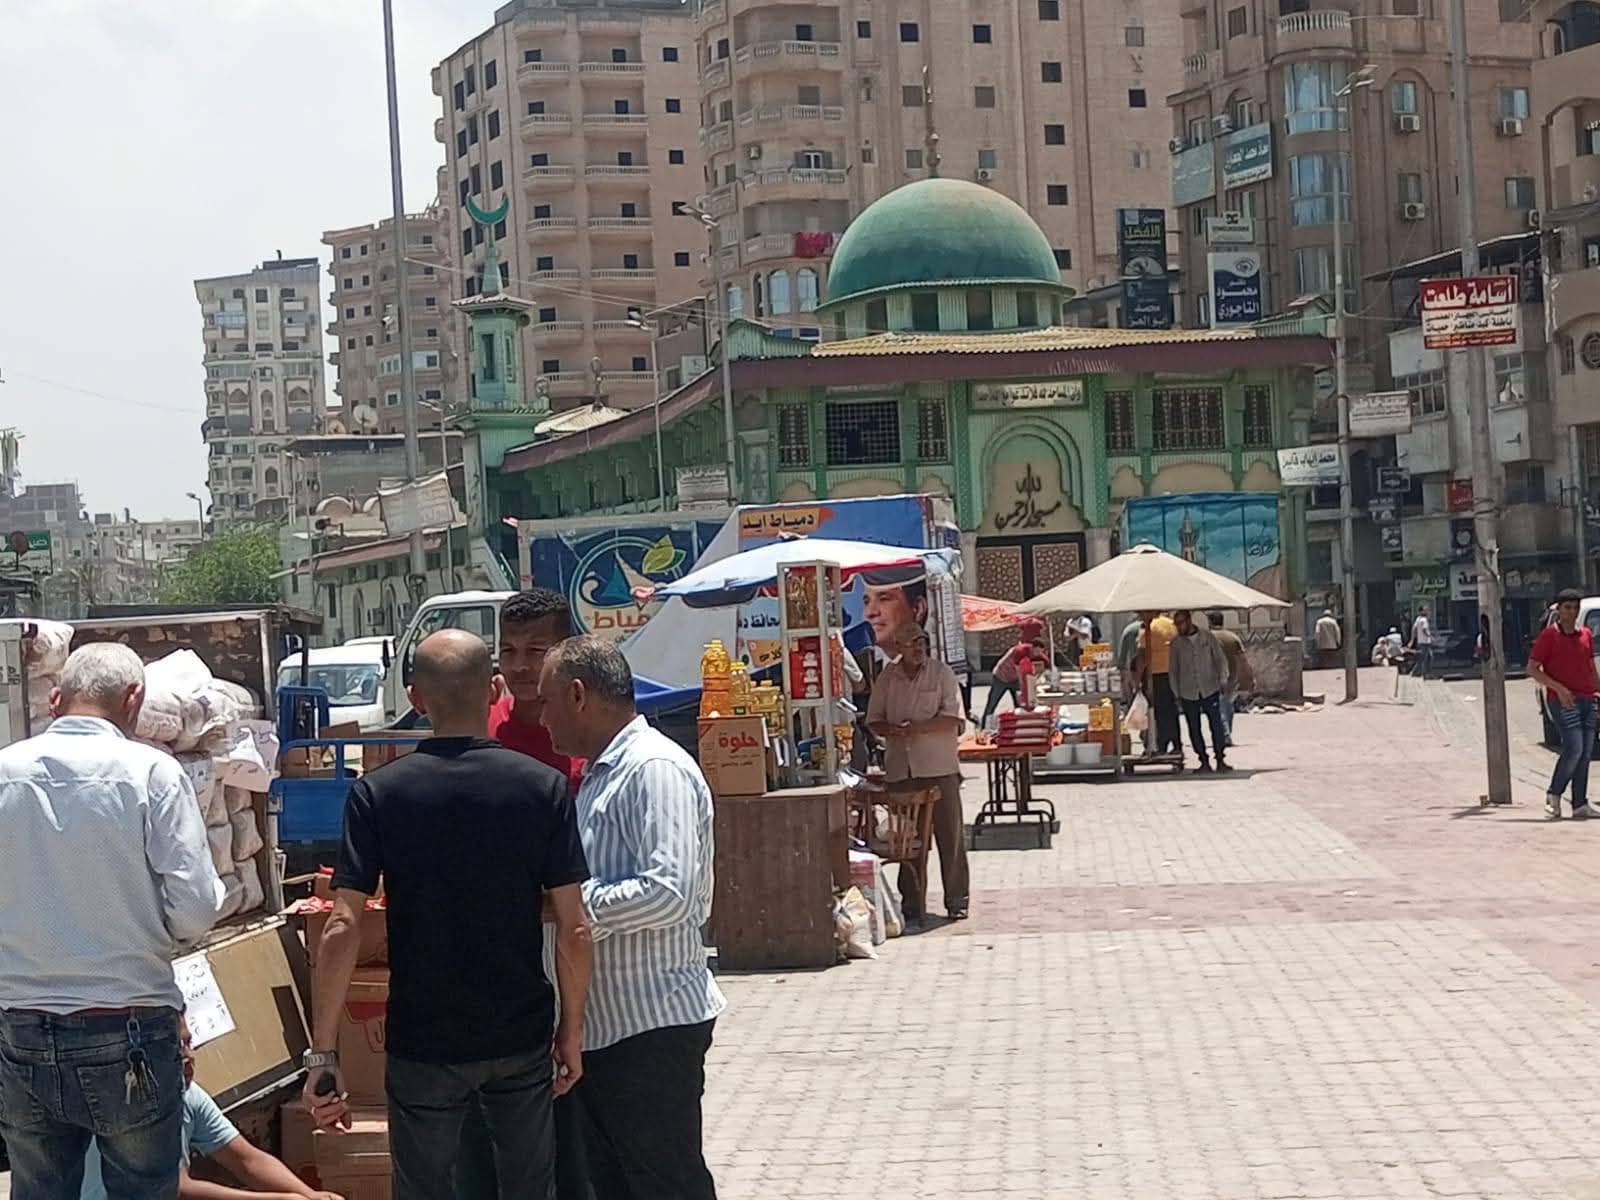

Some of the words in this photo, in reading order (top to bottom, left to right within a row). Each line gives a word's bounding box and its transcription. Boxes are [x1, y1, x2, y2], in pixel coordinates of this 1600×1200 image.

[1216, 286, 1258, 299] محمود
[1424, 285, 1467, 309] طلعت
[1469, 278, 1513, 305] أسامة
[770, 513, 815, 530] دمياط
[995, 500, 1036, 530] الرحمن
[1022, 501, 1062, 528] مسجد
[593, 609, 651, 633] مياط
[719, 731, 760, 754] حلوة
